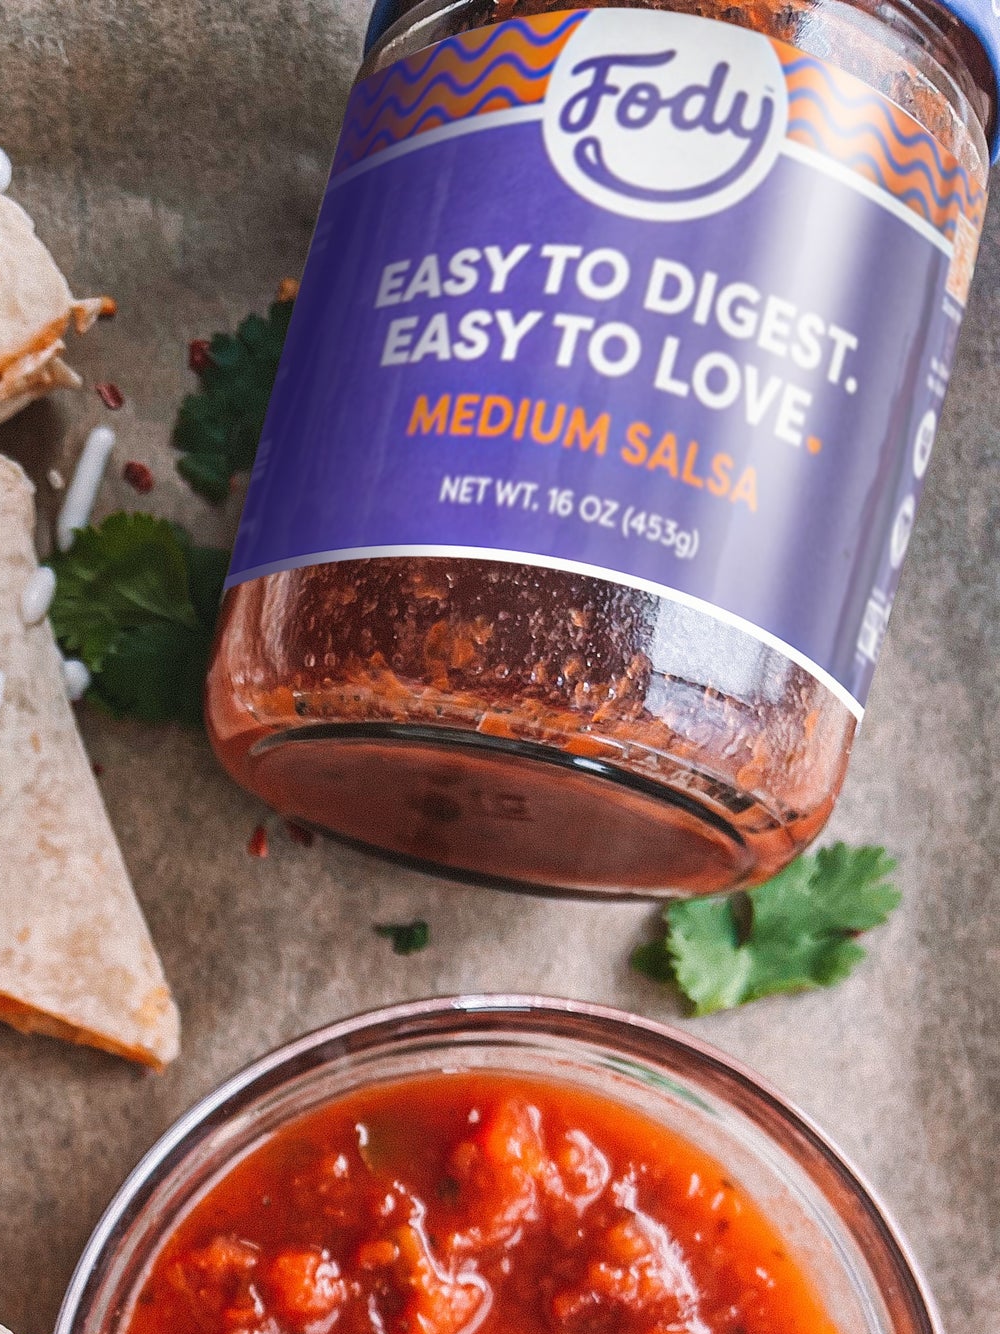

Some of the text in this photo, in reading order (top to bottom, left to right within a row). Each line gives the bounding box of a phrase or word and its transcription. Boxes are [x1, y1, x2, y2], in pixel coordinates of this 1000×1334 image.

[558, 49, 774, 203] Fody
[374, 244, 531, 308] EASY
[541, 244, 630, 300] TO
[643, 258, 858, 395] DIGEST.
[380, 310, 543, 367] EASY
[552, 314, 641, 377] TO
[407, 394, 758, 513] MEDIUM SALSA
[439, 475, 700, 560] NET WT. 16 OZ (453g)
